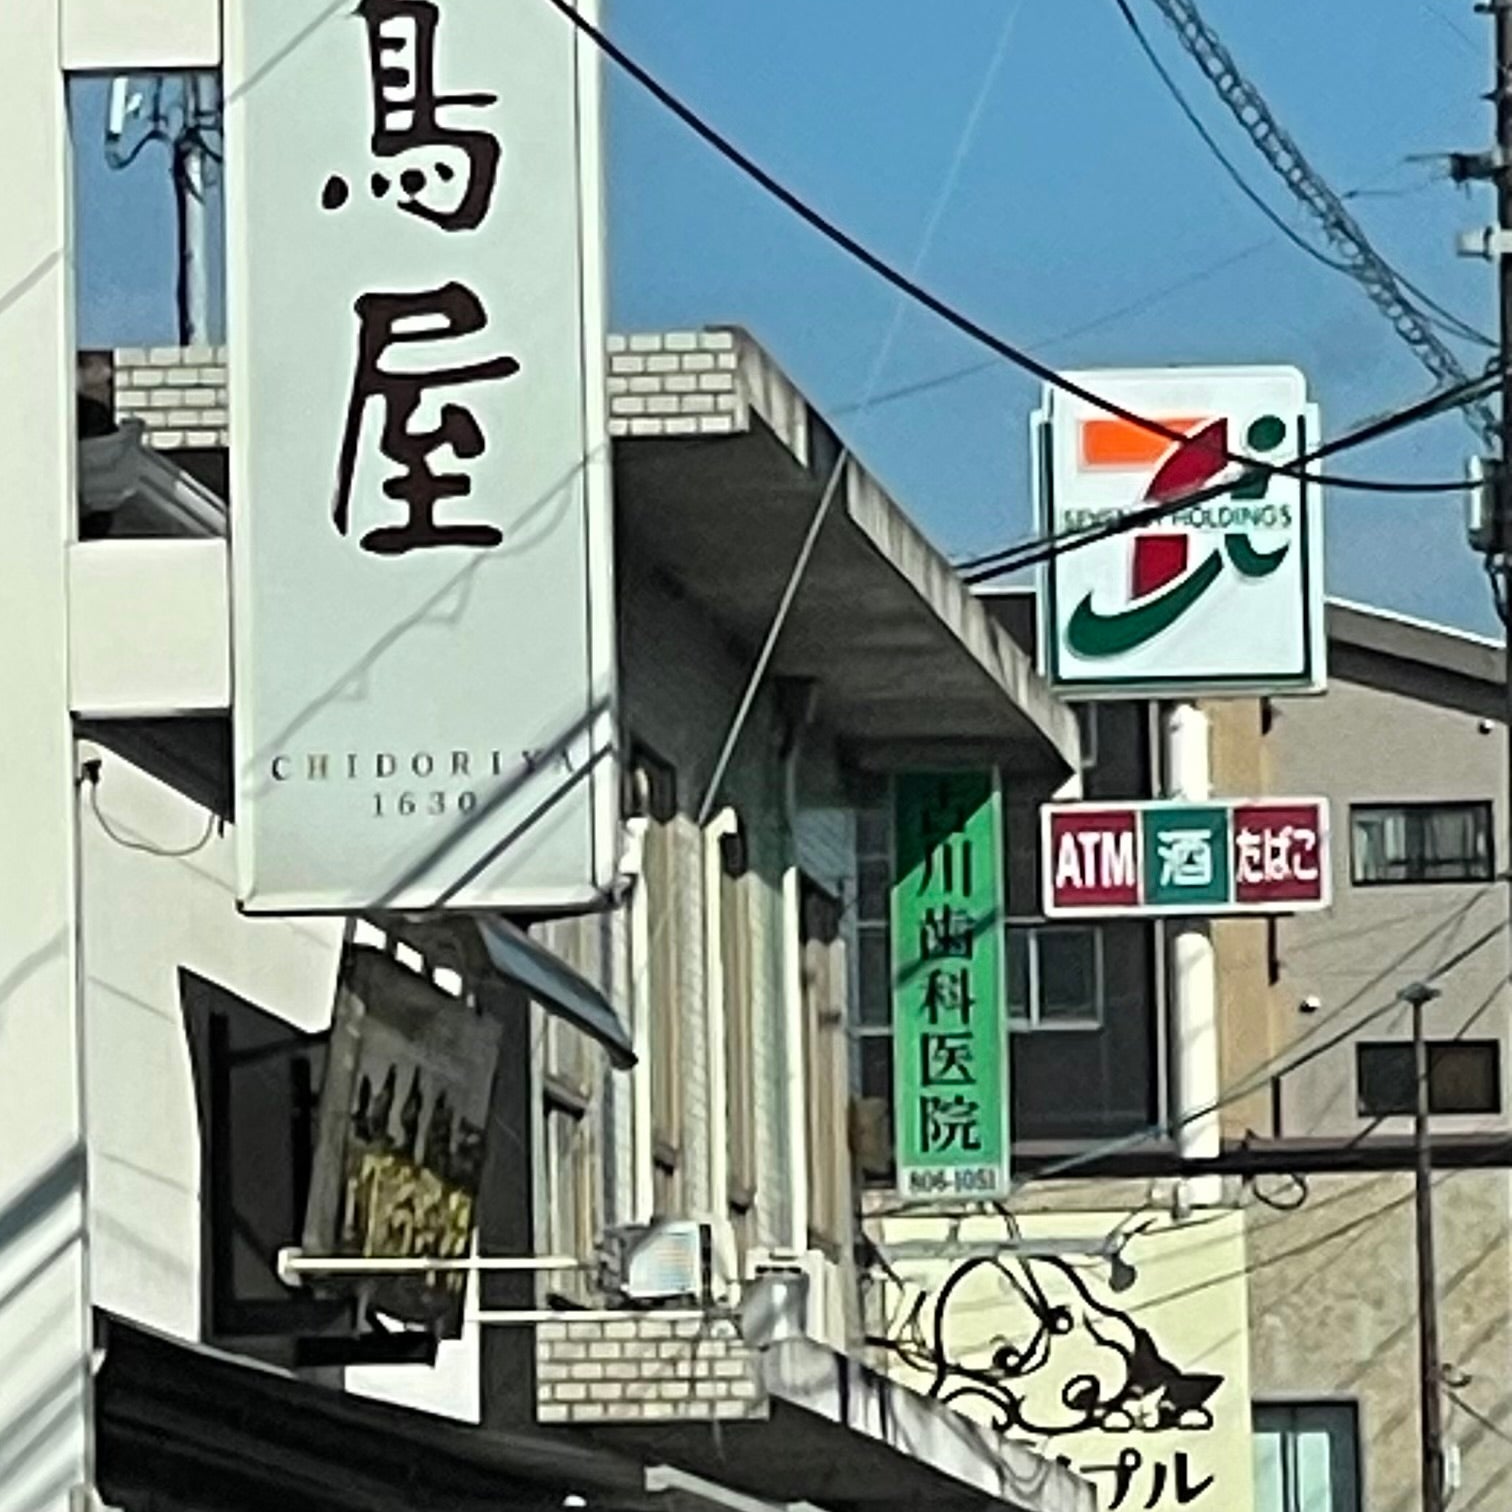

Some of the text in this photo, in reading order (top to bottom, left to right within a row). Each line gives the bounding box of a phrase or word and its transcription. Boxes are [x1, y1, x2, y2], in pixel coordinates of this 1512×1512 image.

[372, 790, 479, 818] 1630
[1056, 826, 1319, 888] ATM 酒 たばこ
[1057, 1448, 1214, 1509] プル
